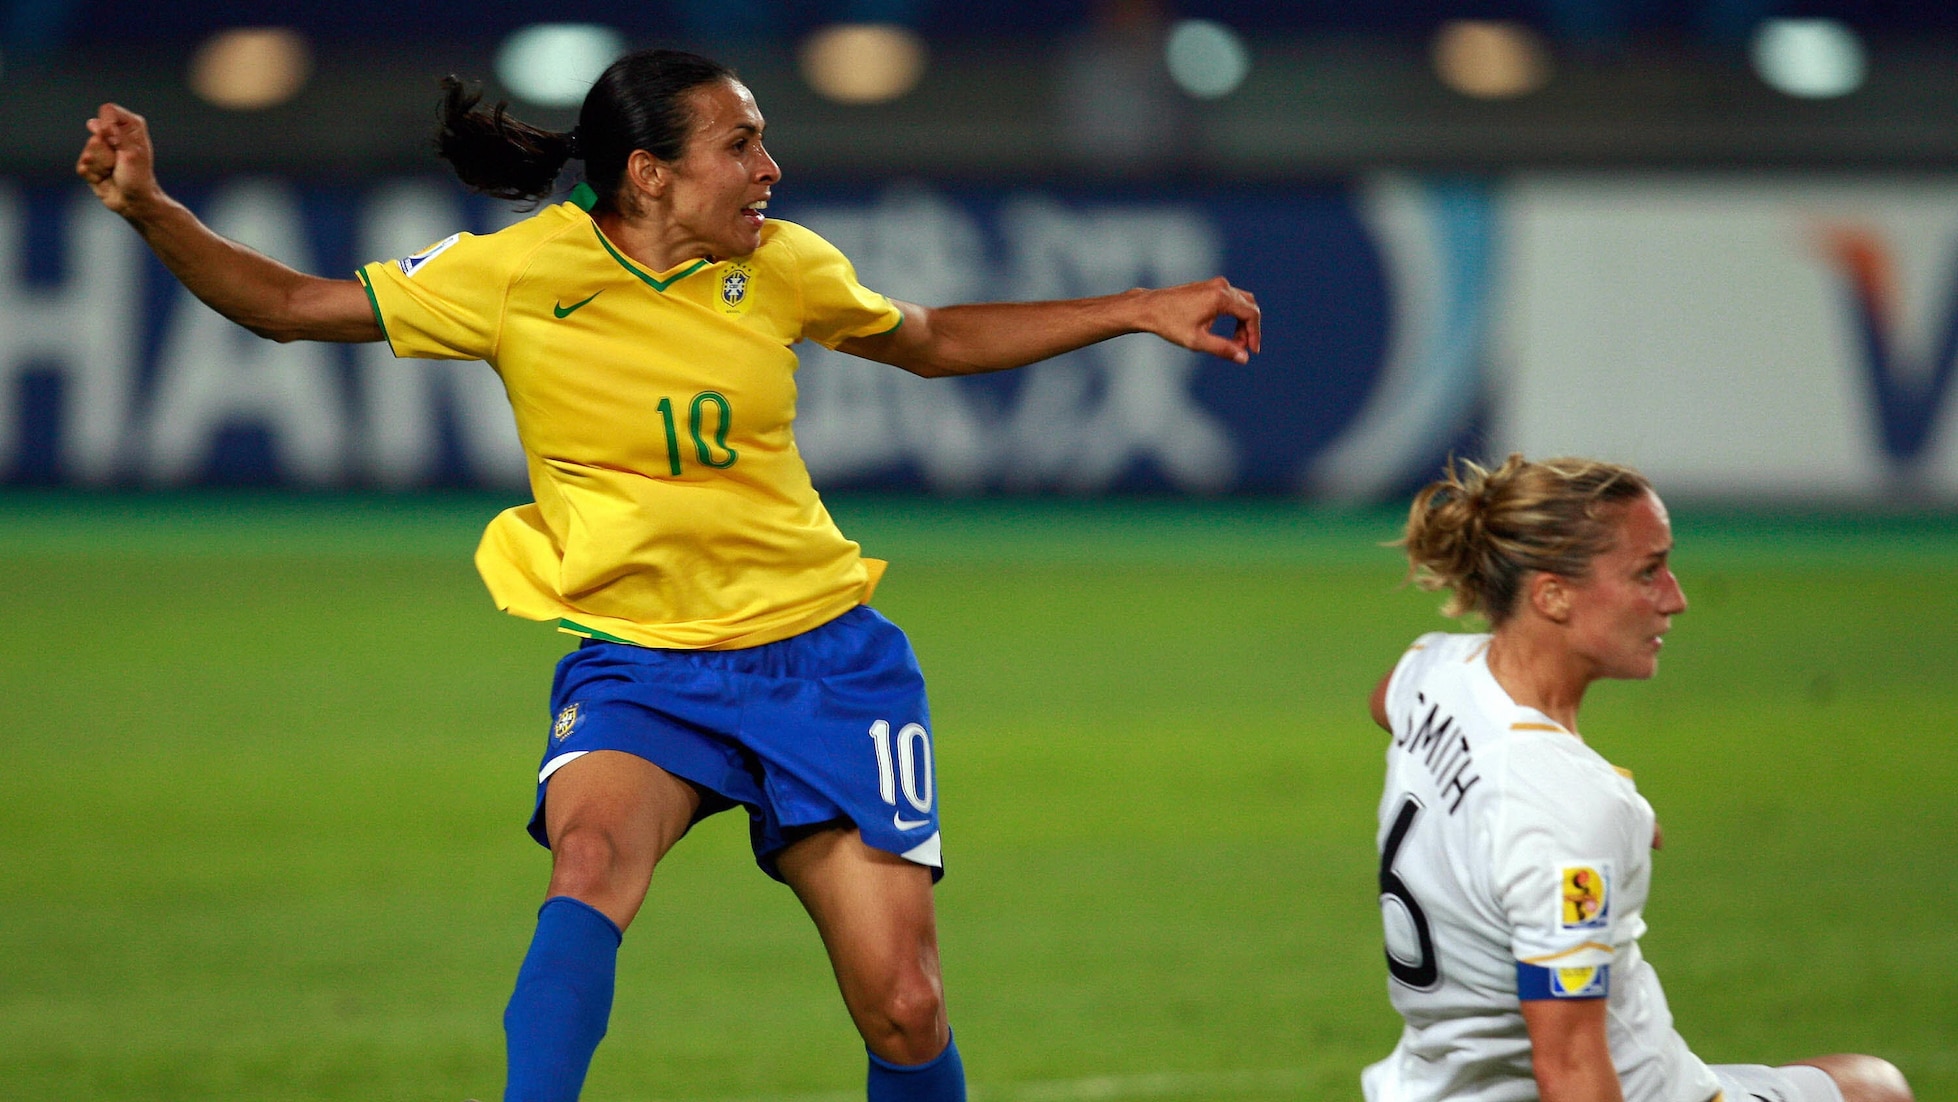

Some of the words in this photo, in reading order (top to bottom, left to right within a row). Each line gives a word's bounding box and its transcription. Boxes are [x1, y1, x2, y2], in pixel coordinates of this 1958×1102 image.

[656, 390, 738, 476] 10
[868, 719, 933, 814] 10
[1397, 691, 1481, 816] SMITH
[1379, 792, 1440, 993] 6
